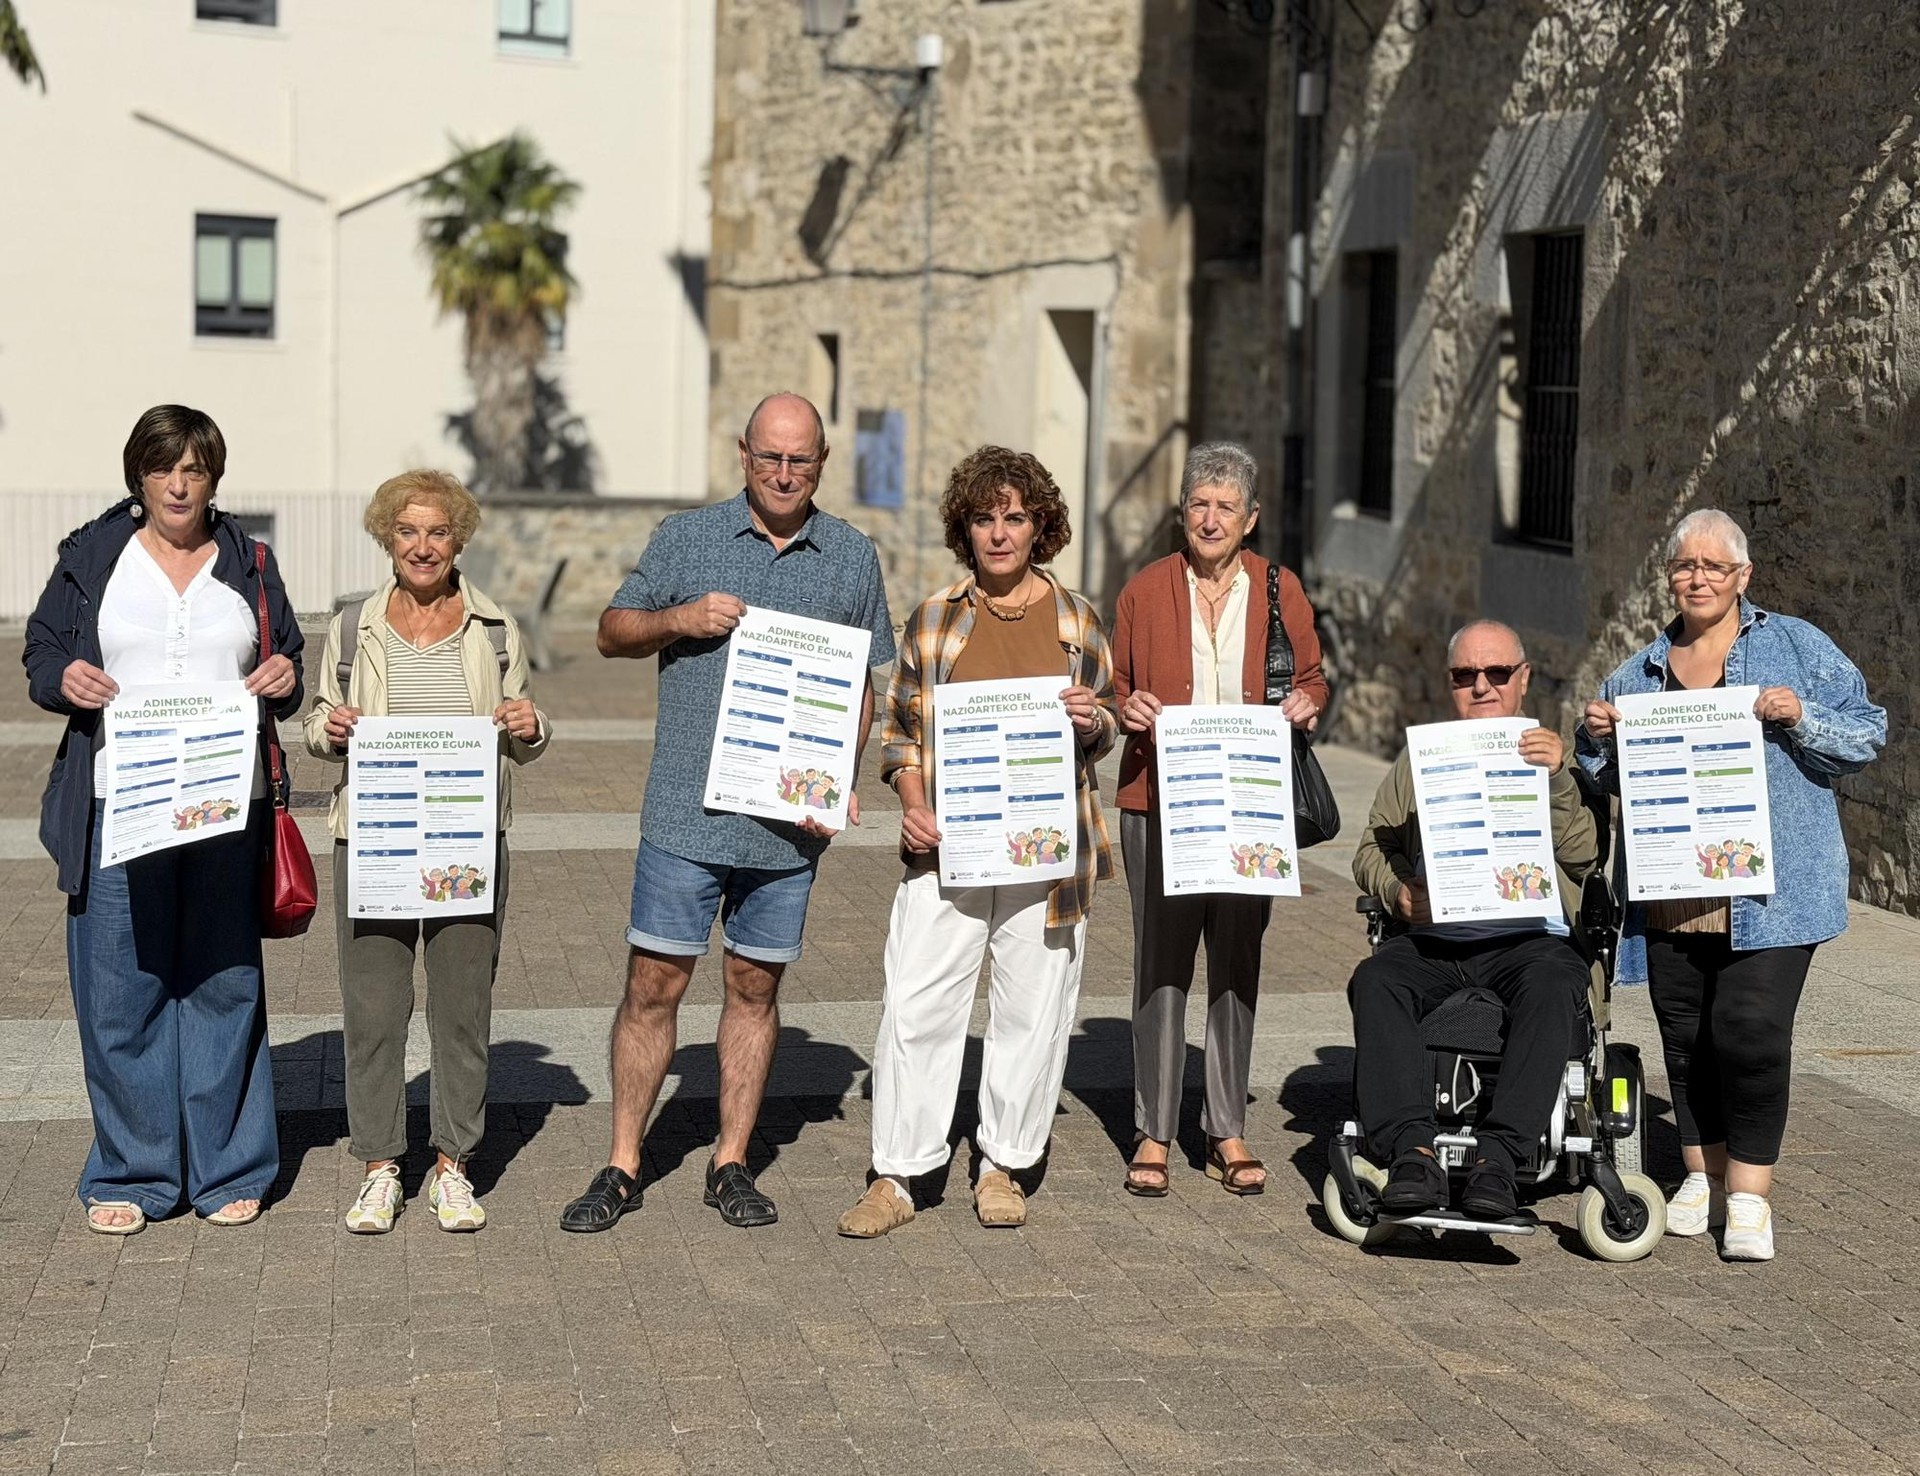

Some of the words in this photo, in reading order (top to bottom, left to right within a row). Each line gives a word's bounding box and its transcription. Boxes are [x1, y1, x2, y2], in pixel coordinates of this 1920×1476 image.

[768, 626, 830, 644] ADINEKOEN
[740, 630, 815, 652] NAZIOARTEKO
[817, 646, 853, 660] EGUNA
[144, 697, 212, 707] ADINEKOEN
[968, 693, 1031, 704] ADINEKOEN
[114, 708, 198, 719] NAZIOARTEKO
[944, 704, 1017, 716] NAZIOARTEKO
[1022, 702, 1058, 711] EGUNA
[1652, 704, 1717, 715] ADINEKOEN
[1625, 715, 1703, 727] NAZIOARTEKO
[1707, 712, 1746, 721] EGUNA
[387, 731, 453, 739] ADINEKOEN
[1165, 727, 1240, 736] NAZIOARTEKO
[1243, 728, 1277, 736] EGUNA
[358, 741, 439, 749] NAZIOARTEKO
